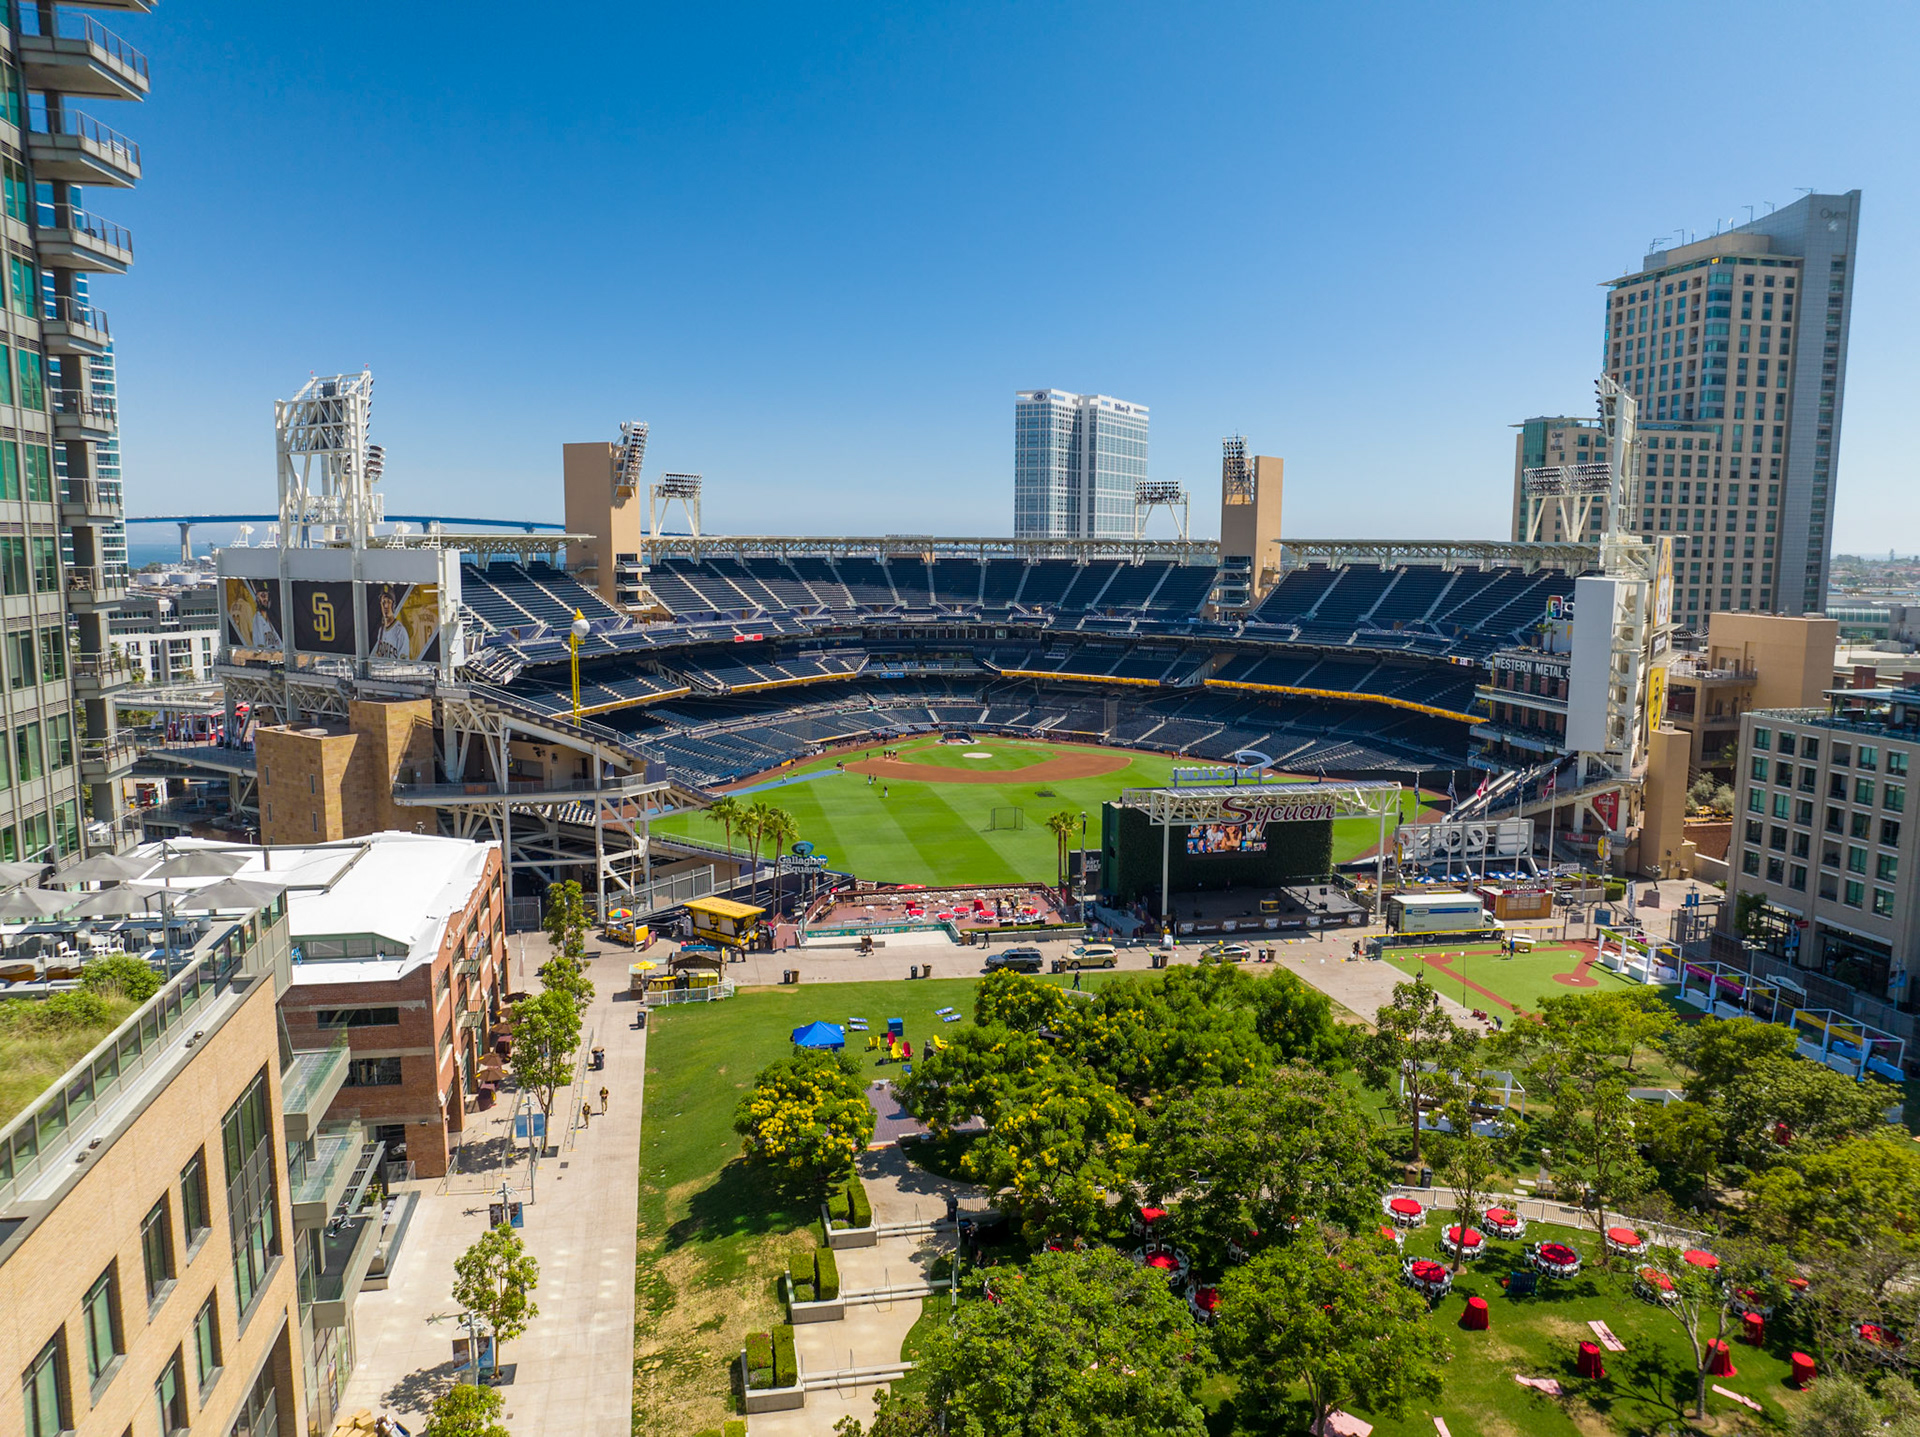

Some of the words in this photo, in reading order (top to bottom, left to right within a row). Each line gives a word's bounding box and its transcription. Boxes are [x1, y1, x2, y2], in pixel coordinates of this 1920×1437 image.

[1494, 657, 1532, 673] WESTERN
[1535, 663, 1564, 679] METAL
[1220, 795, 1335, 833] Sycuan
[778, 855, 828, 867] Gallagher
[785, 864, 821, 875] Square
